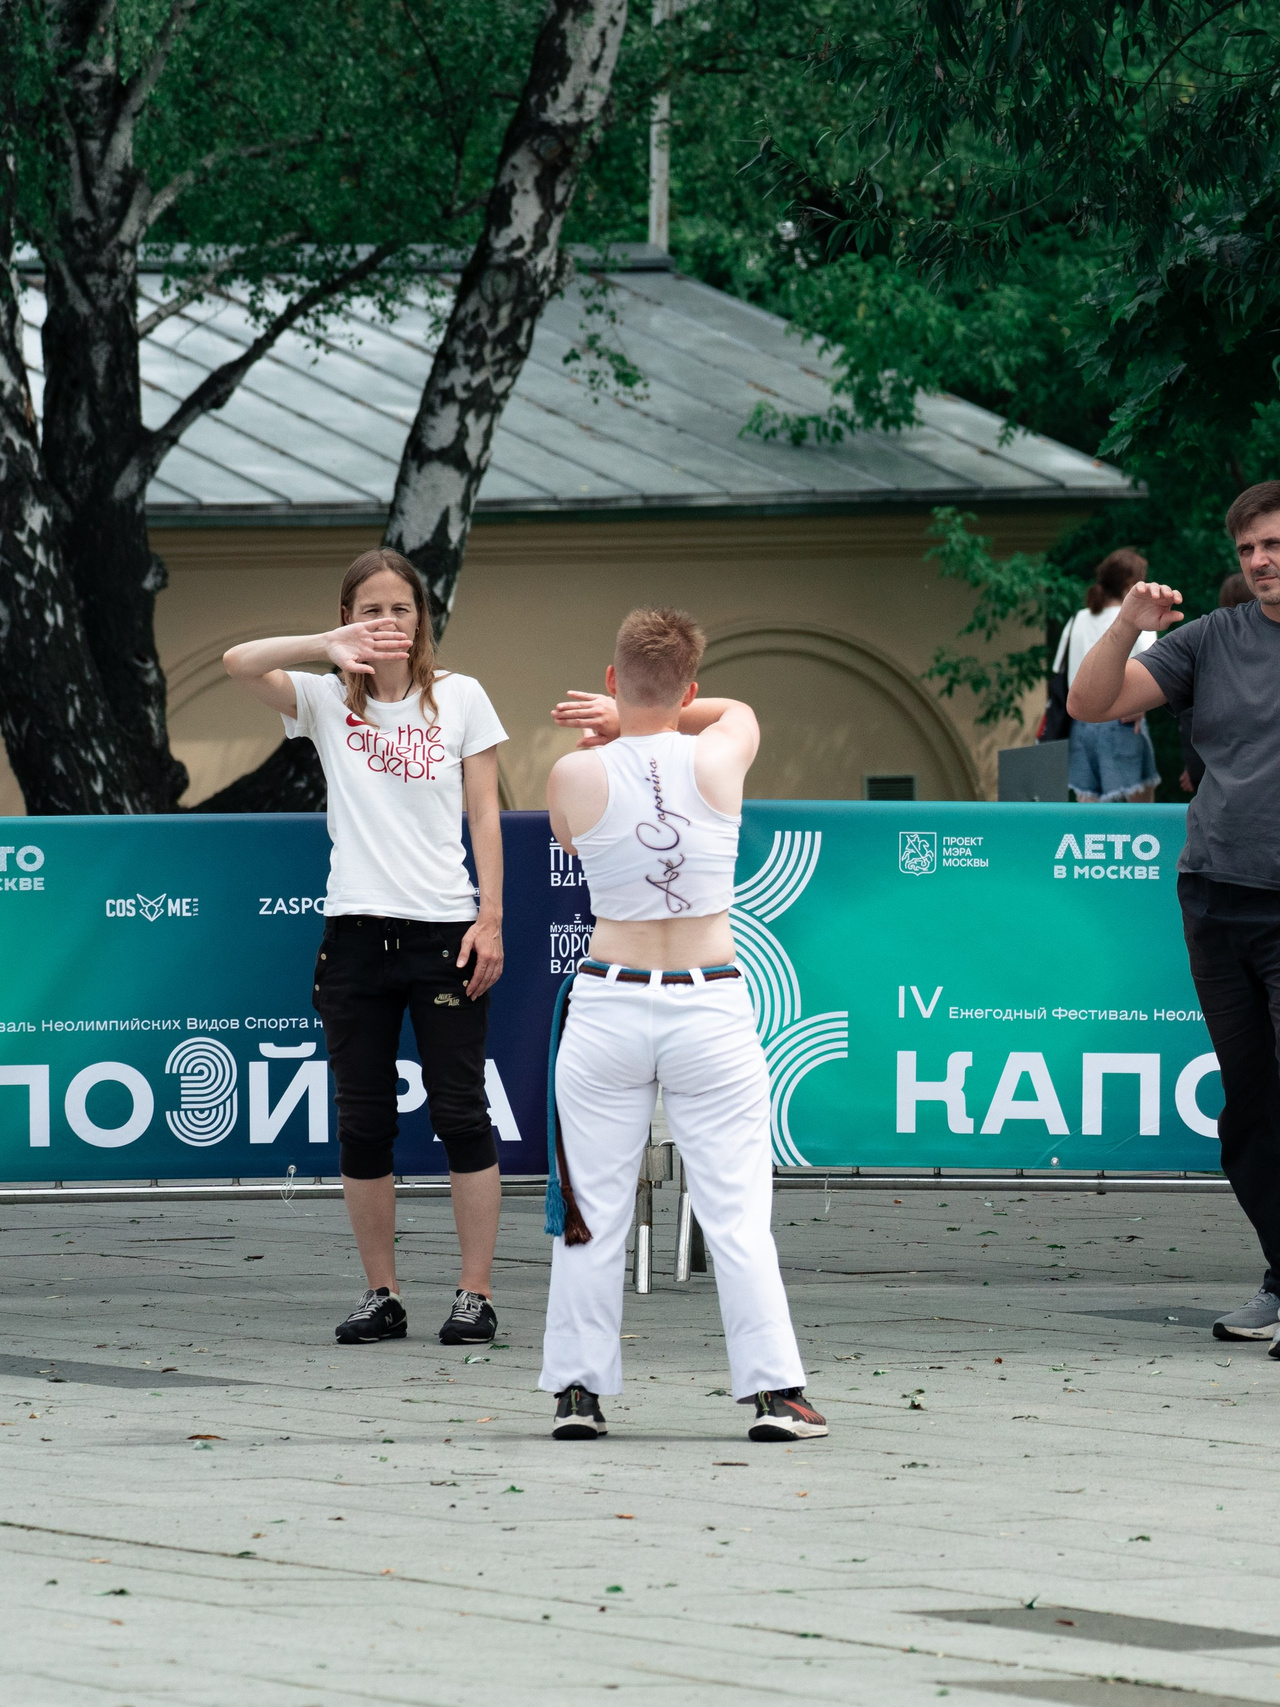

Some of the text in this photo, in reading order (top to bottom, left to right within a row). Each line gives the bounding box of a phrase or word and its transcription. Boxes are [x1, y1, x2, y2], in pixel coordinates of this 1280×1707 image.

[398, 724, 442, 746] the
[346, 729, 445, 762] athletic
[367, 750, 436, 783] dept.
[635, 757, 691, 851] Capoeira
[942, 836, 984, 847] ПРОЕКТ
[1054, 833, 1161, 861] ЛЕТО
[942, 847, 973, 858] МЭРА
[942, 858, 990, 868] МОСКВЫ
[1053, 865, 1160, 880] В МОСКВЕ
[0, 877, 45, 892] КВЕ
[898, 986, 944, 1019] IV
[949, 1007, 1047, 1022] Ежегодный
[1051, 1007, 1149, 1021] Фестиваль
[41, 1016, 182, 1033] Неолимпийских
[186, 1016, 240, 1031] Видов
[244, 1015, 310, 1031] Спорта
